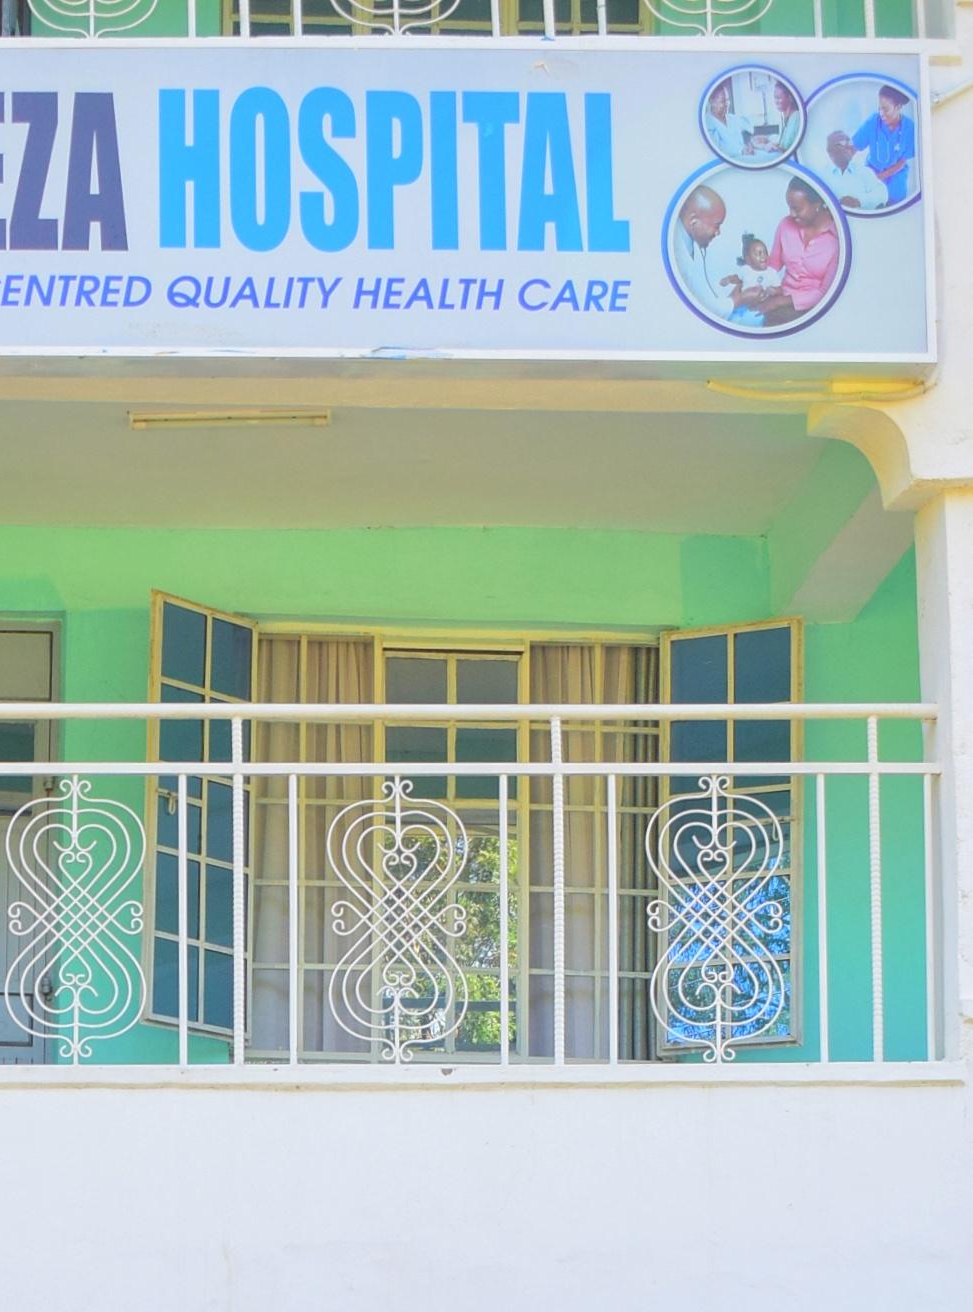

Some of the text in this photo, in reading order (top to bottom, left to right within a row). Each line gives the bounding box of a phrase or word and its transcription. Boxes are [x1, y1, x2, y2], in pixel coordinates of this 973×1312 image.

[158, 85, 632, 254] HOSPITAL
[166, 275, 342, 309] QUALITY
[353, 277, 504, 310] HEALTH
[517, 278, 632, 312] CARE
